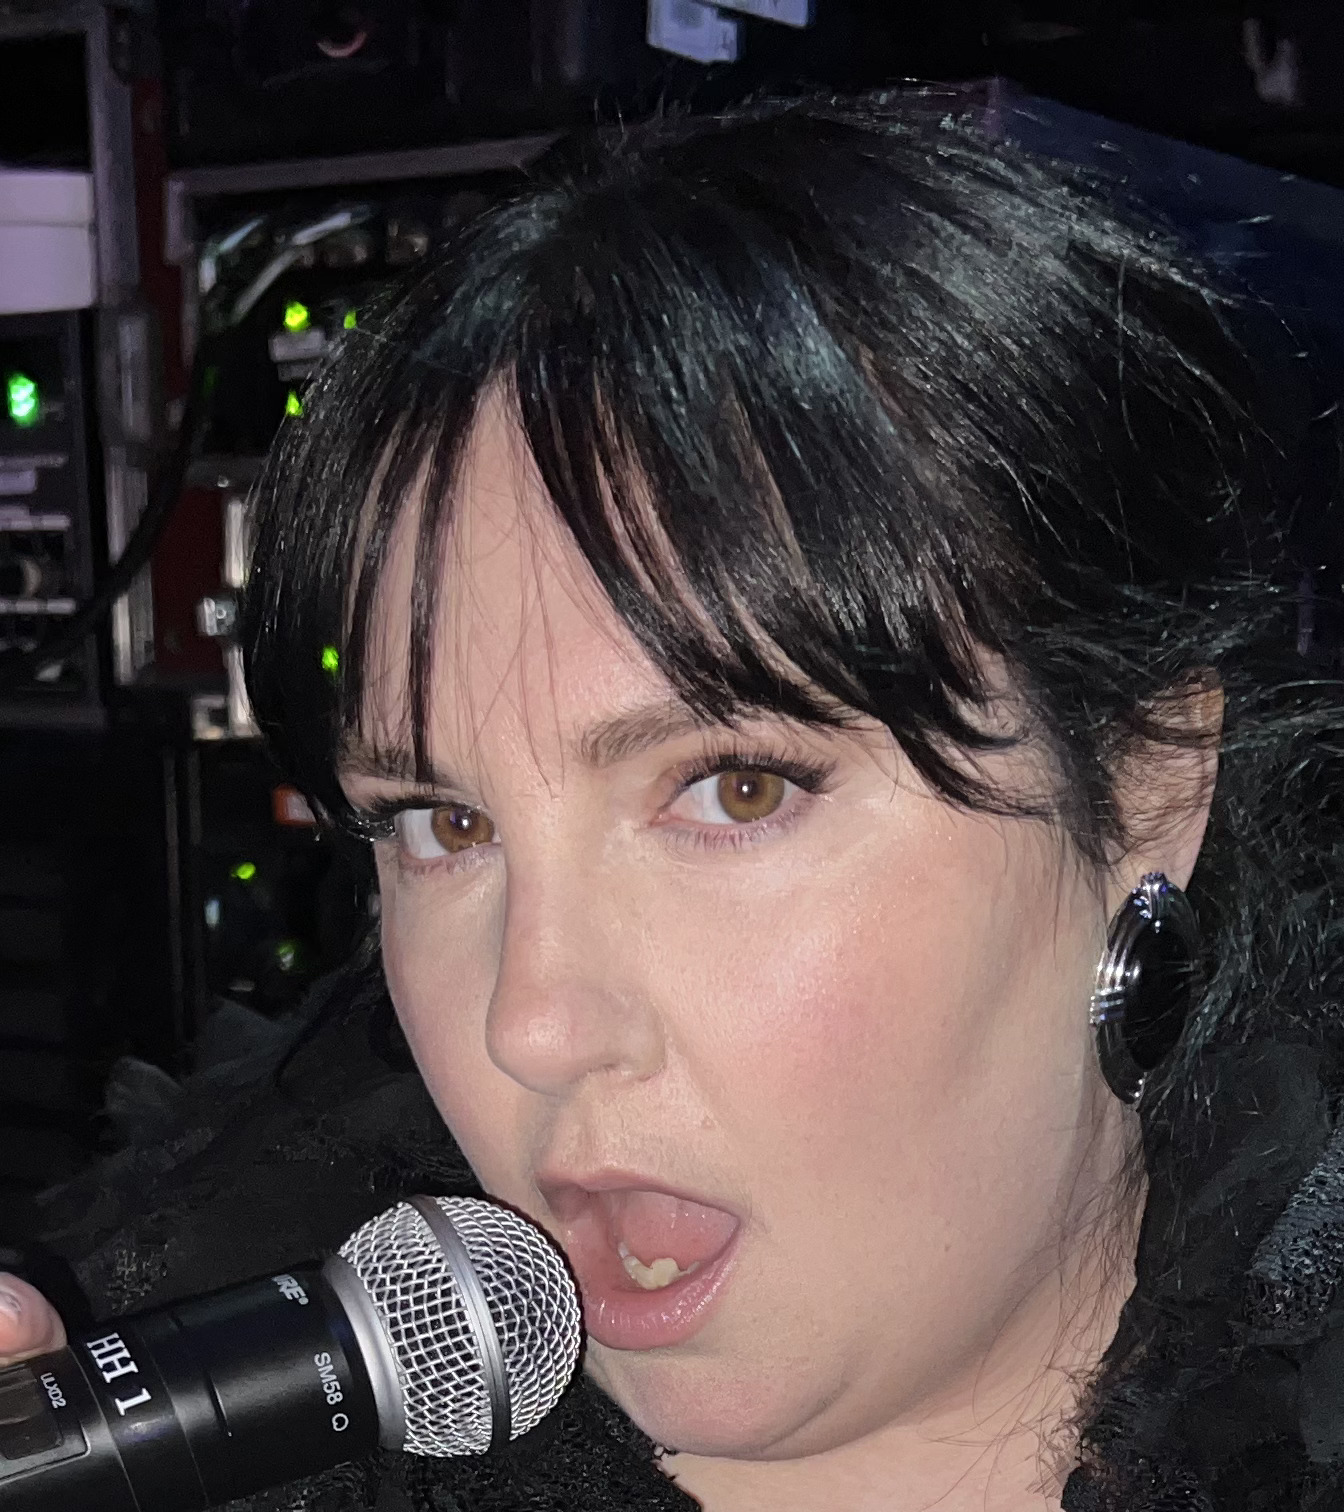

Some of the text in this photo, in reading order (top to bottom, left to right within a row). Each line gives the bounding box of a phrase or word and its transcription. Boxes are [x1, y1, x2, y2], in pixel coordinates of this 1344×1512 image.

[86, 1332, 152, 1417] HH 1
[313, 1351, 344, 1406] SM58
